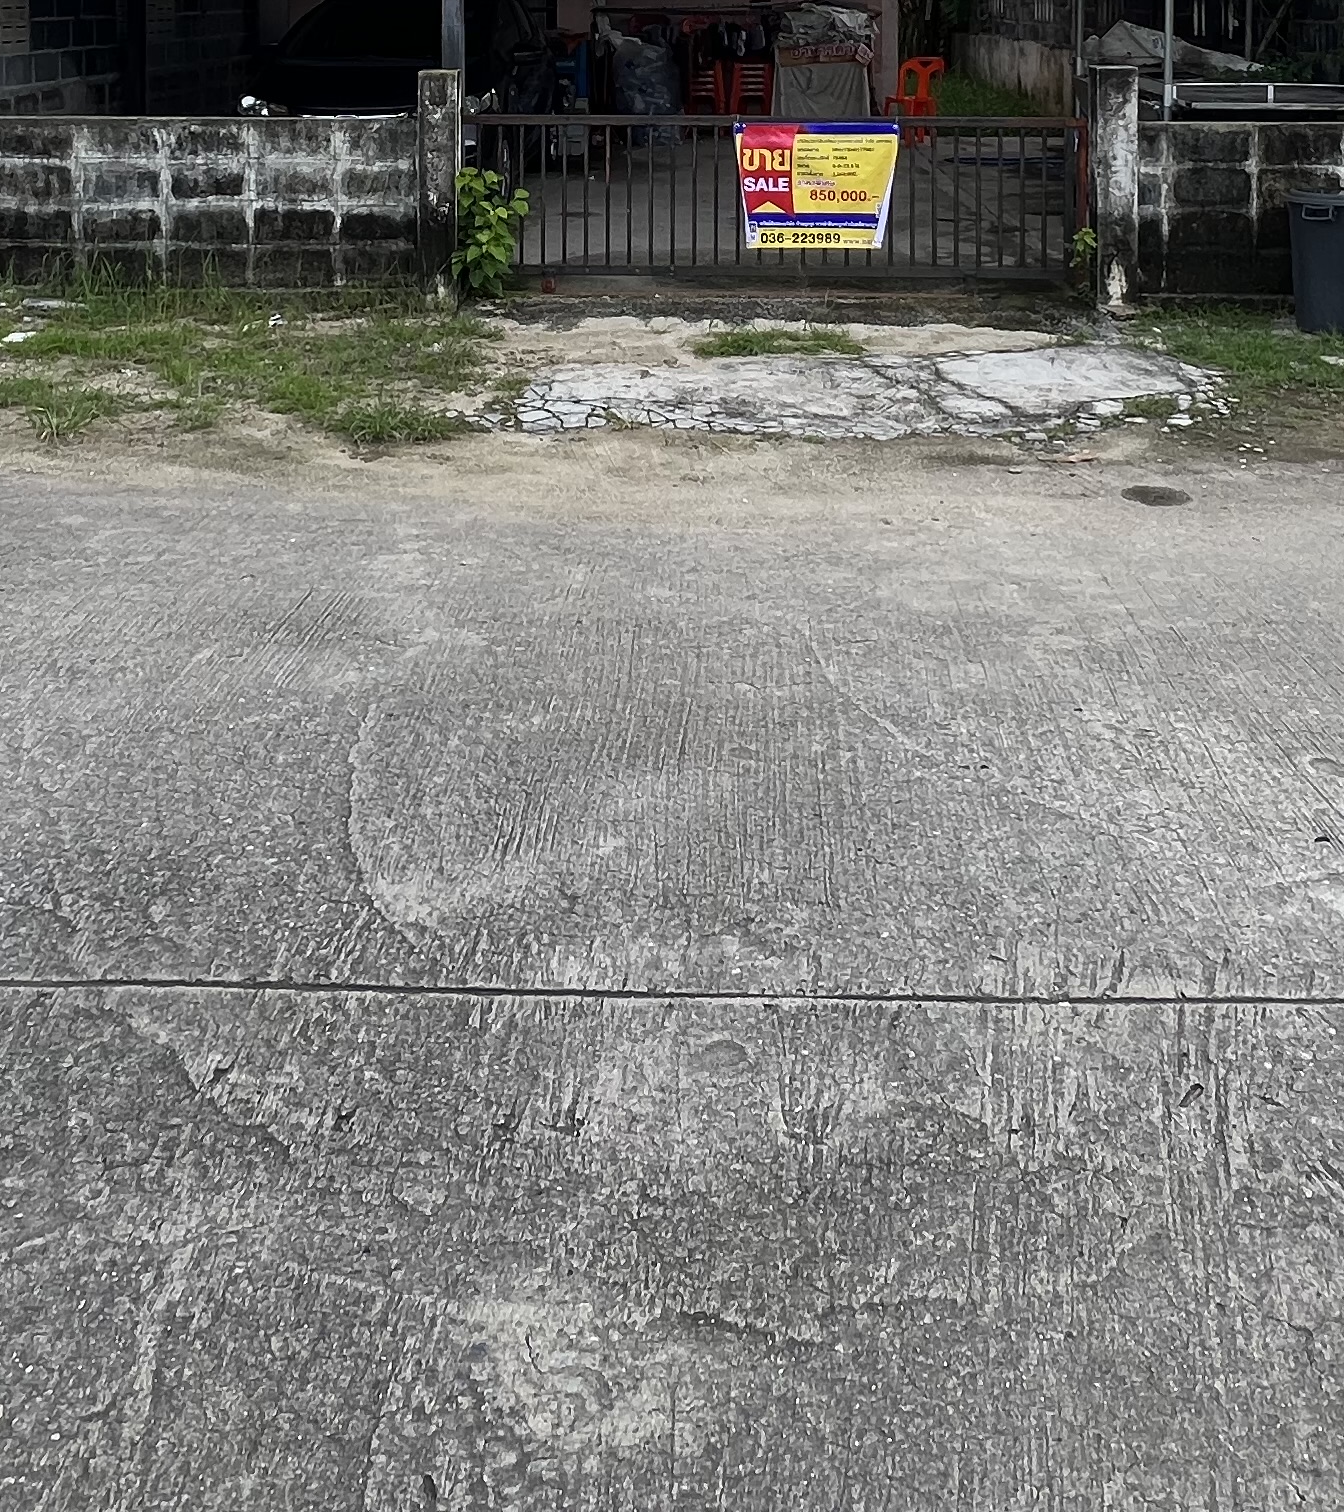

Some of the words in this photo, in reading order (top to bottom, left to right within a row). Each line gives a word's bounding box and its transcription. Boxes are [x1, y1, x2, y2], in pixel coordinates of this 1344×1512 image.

[743, 149, 791, 171] ขาย
[744, 177, 790, 192] SALE
[809, 189, 880, 203] 850,000.-
[760, 232, 841, 244] 036-223989
